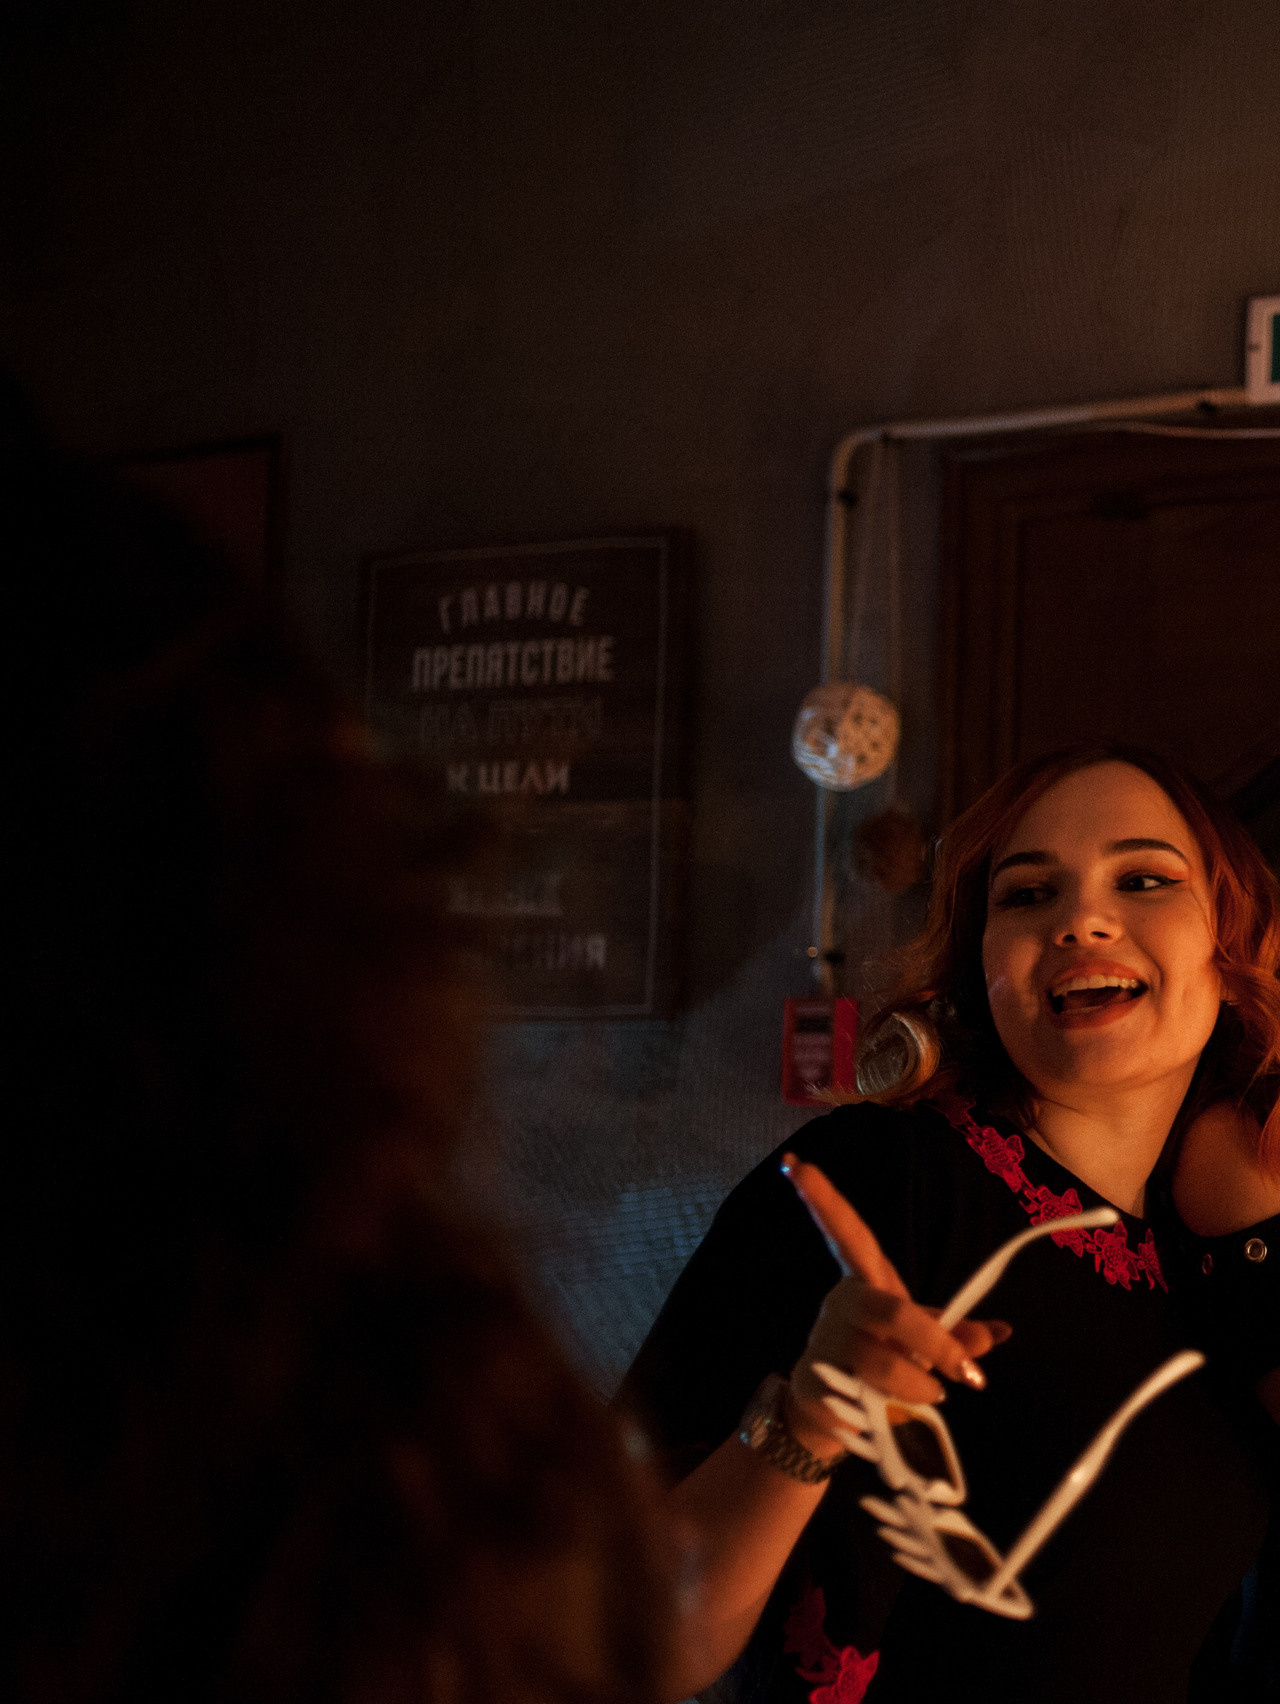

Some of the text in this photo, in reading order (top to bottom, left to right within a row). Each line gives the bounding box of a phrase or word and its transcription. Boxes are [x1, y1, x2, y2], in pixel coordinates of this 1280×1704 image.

[437, 580, 592, 634] ГЛАВНОЕ
[411, 635, 616, 693] ПРЕПЯТСТВИЕ
[446, 758, 571, 795] К ЦЕЛИ
